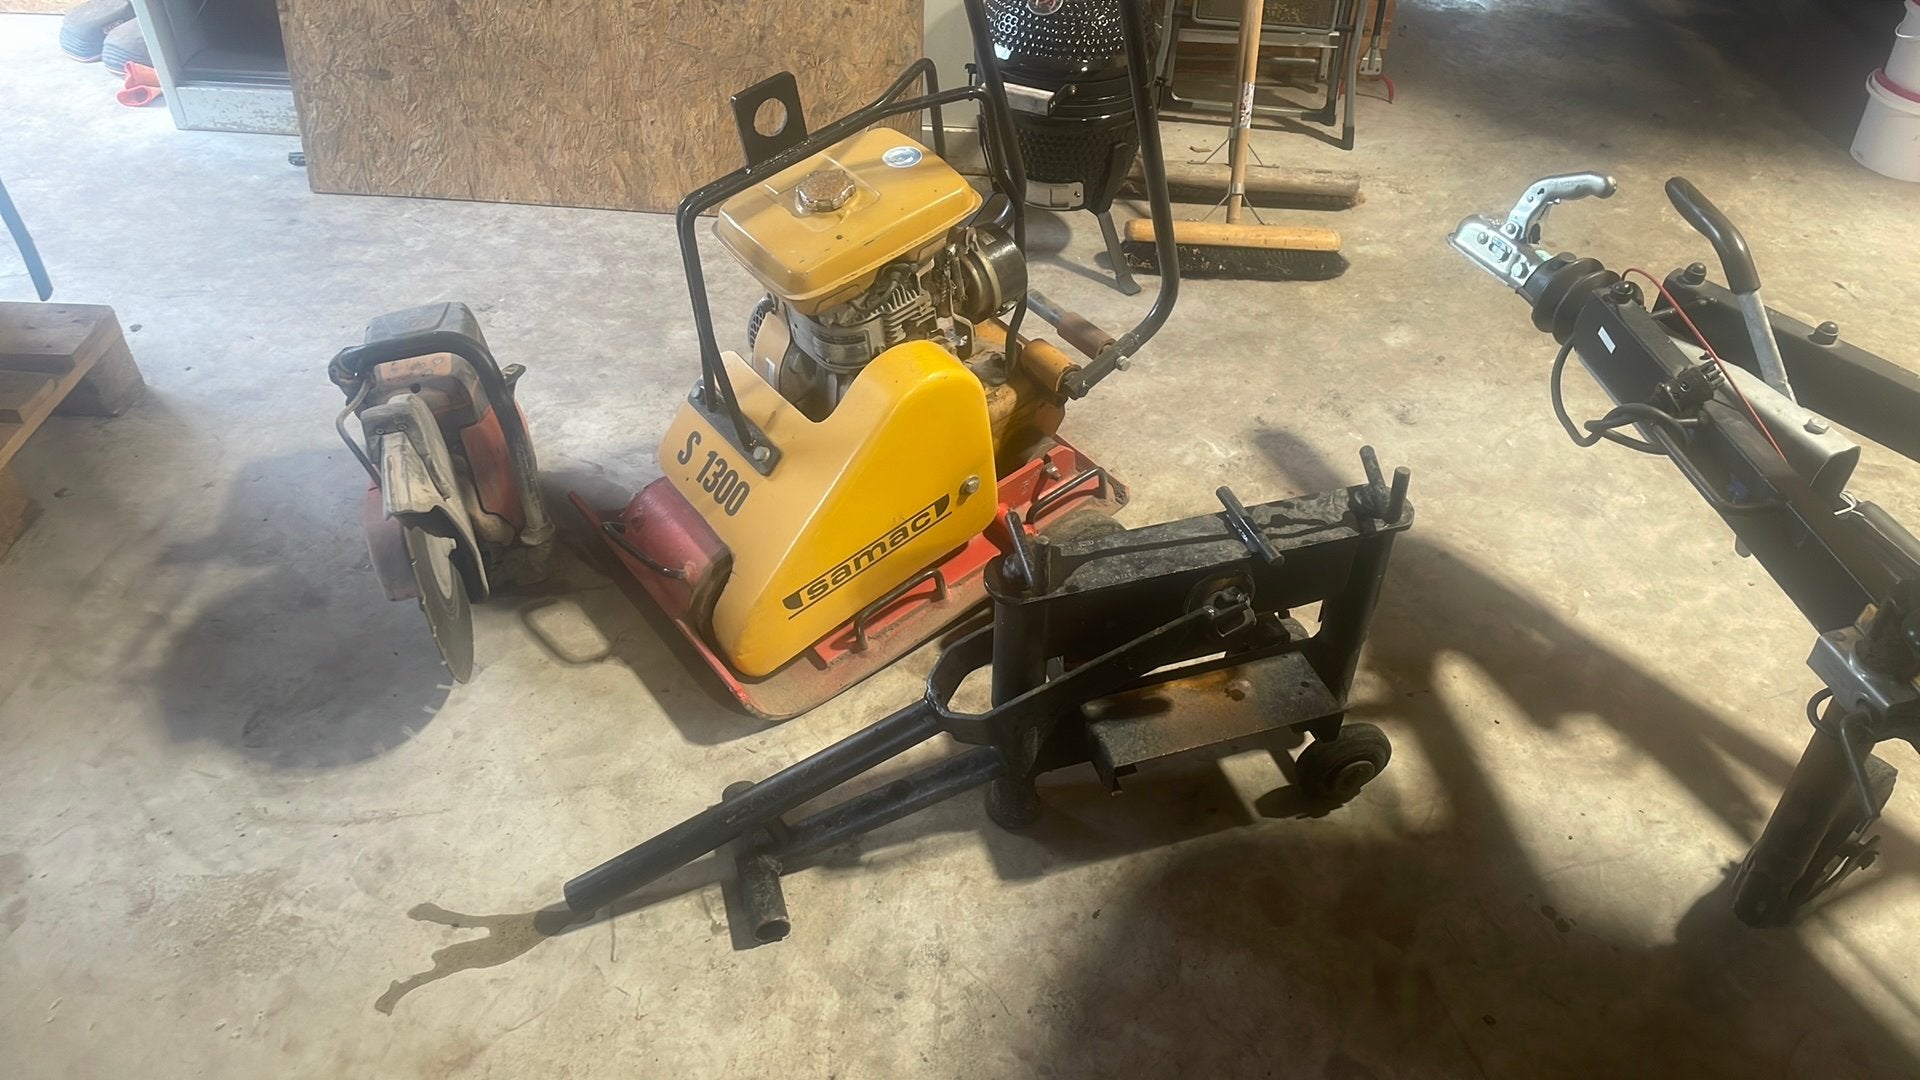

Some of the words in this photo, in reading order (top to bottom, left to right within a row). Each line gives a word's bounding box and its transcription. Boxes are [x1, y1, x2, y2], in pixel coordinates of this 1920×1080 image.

[677, 431, 702, 465] S
[695, 450, 751, 517] 1300
[806, 511, 932, 601] samac
